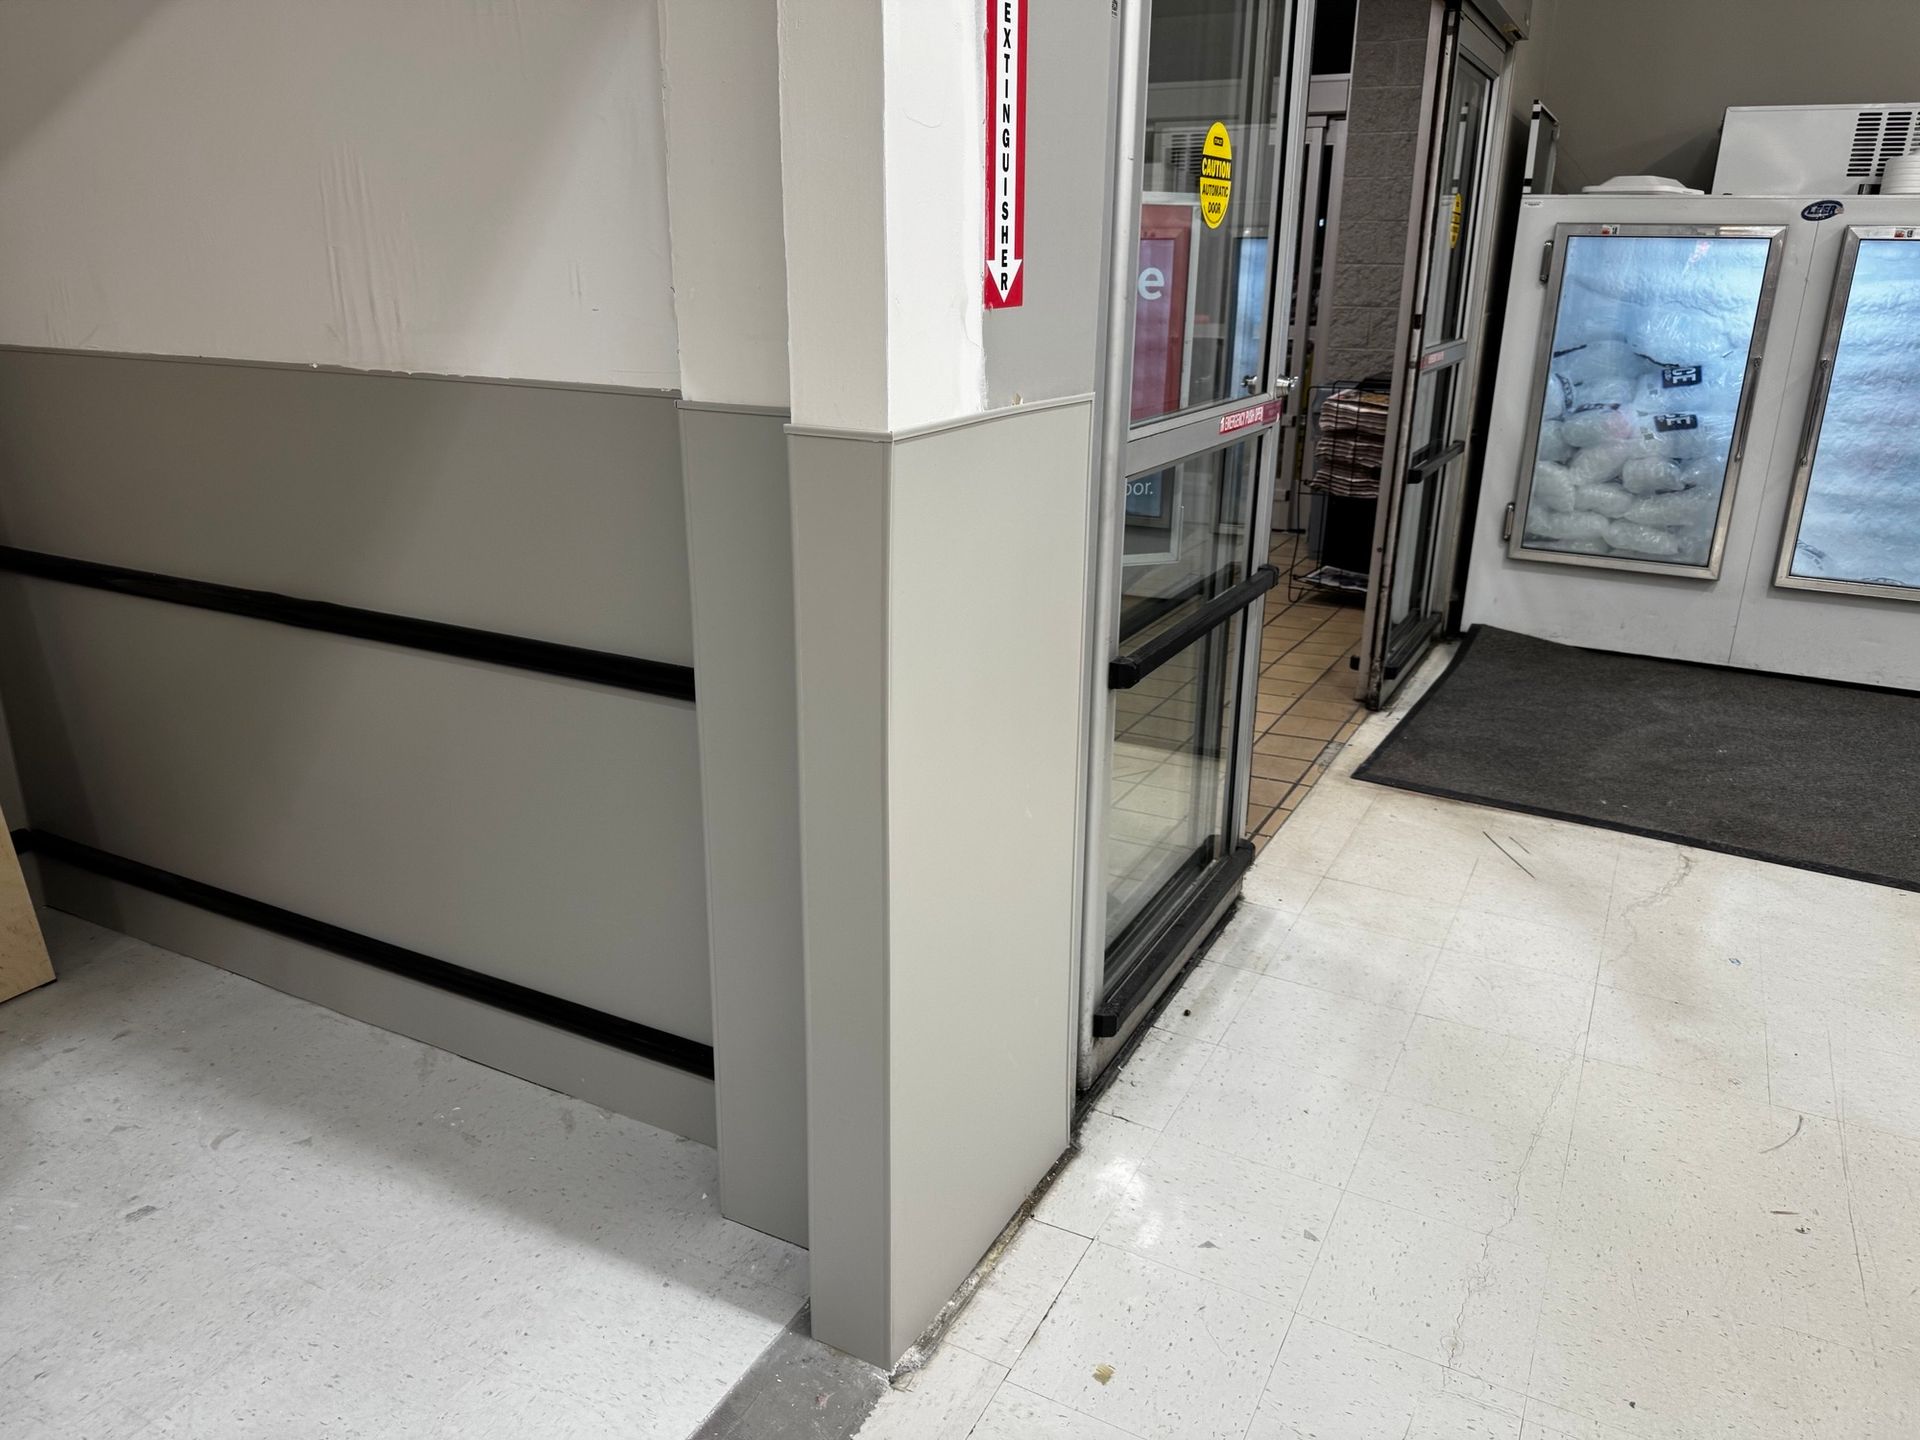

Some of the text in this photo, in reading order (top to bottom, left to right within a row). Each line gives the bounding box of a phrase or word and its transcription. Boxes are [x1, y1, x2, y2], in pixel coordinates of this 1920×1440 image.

[1000, 2, 1011, 290] EXTINGUISHER
[1202, 157, 1231, 179] CAUTION
[1202, 183, 1229, 198] AUTOMATIC
[1208, 201, 1221, 214] DOOR
